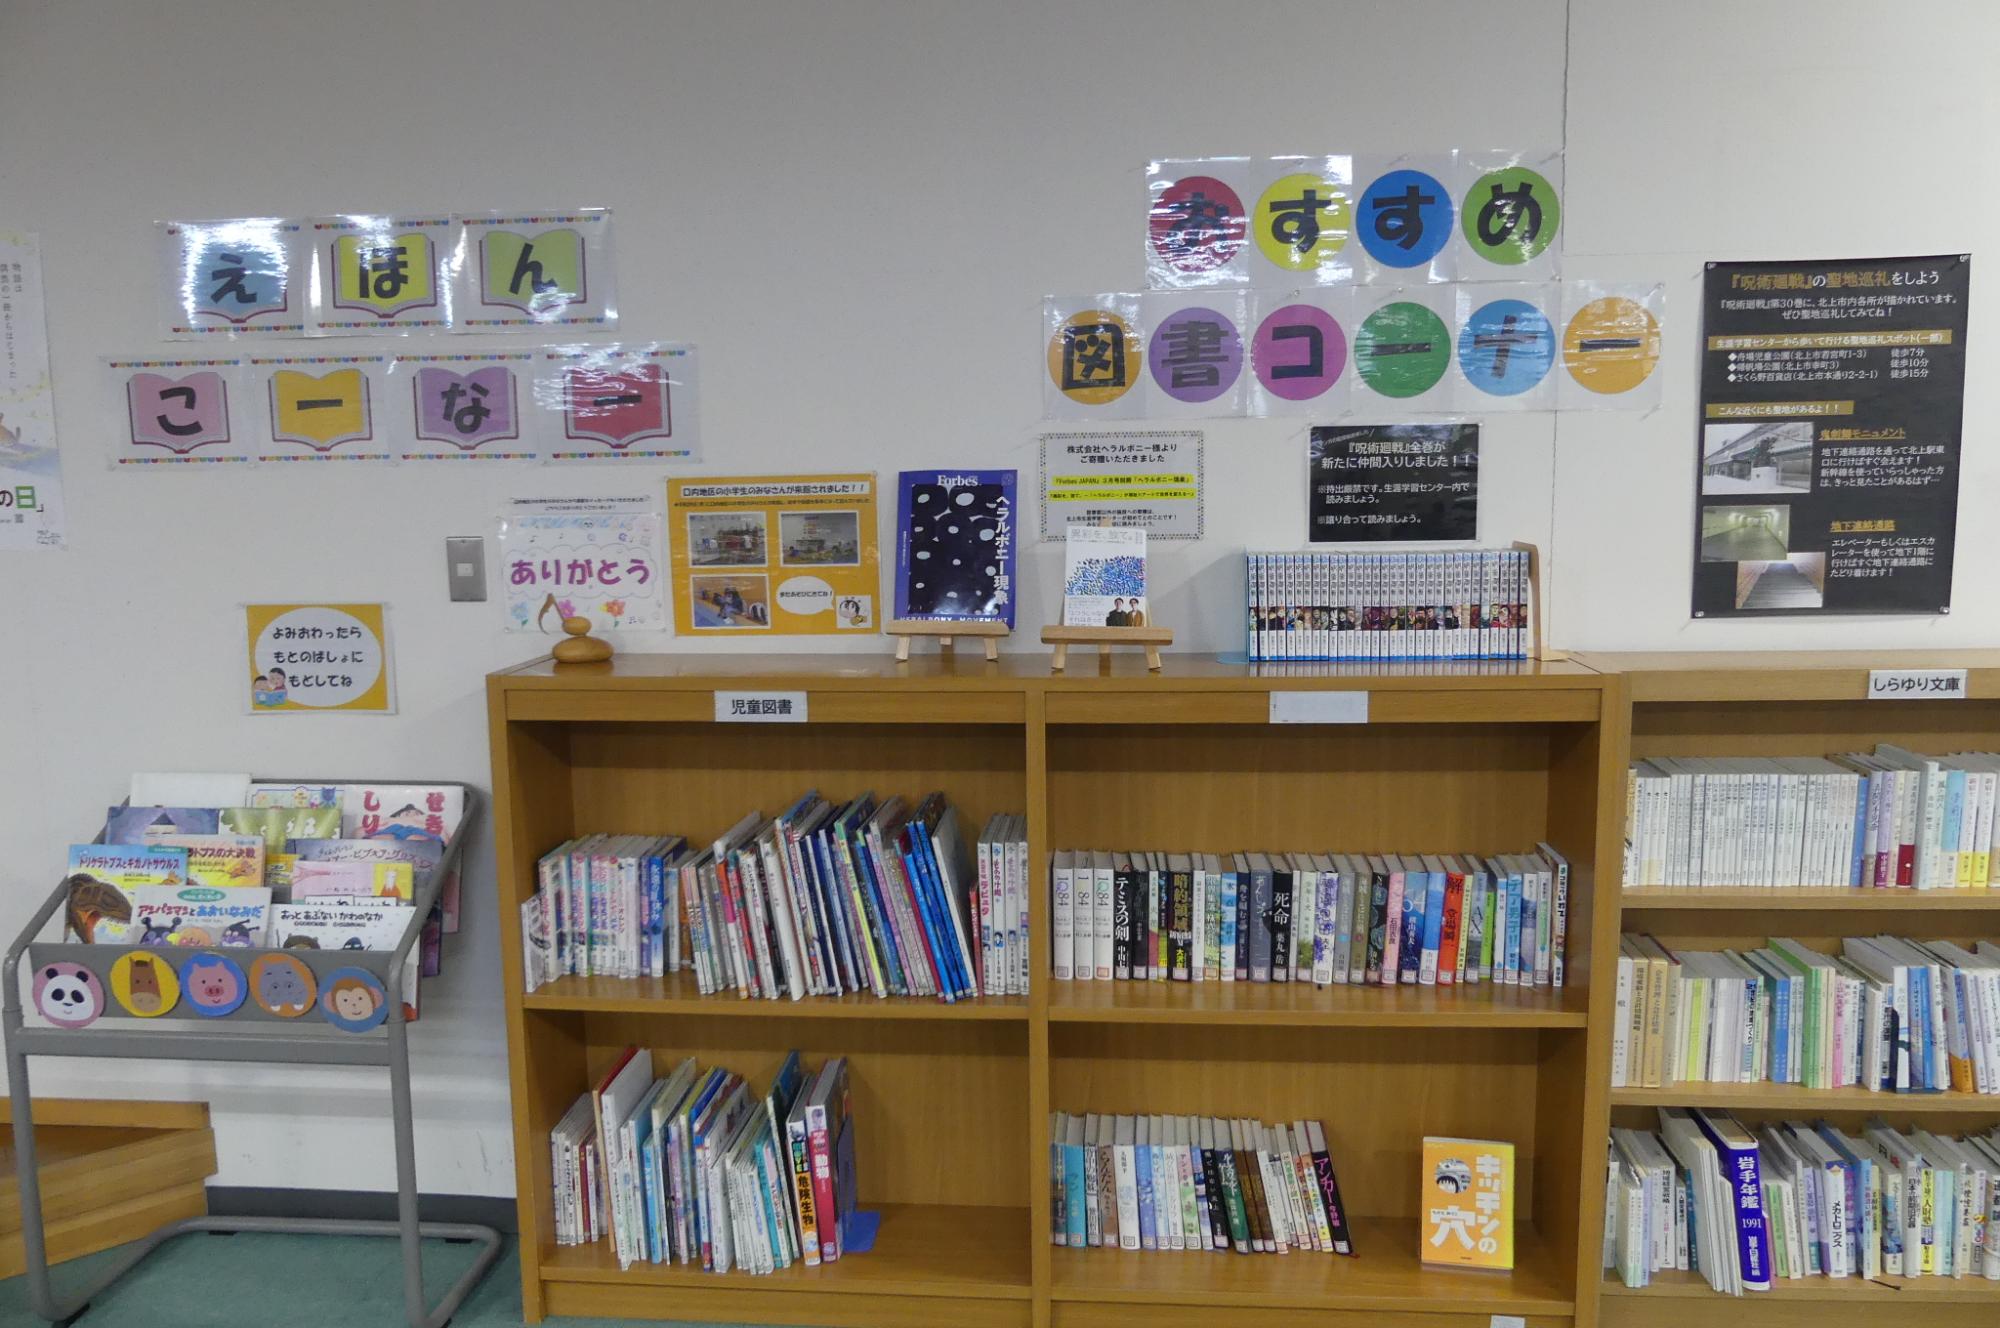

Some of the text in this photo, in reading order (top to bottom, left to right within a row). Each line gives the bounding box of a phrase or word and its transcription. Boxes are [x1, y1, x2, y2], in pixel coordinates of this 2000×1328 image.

[1168, 182, 1543, 253] おすすめ
[210, 243, 559, 304] えほん
[1061, 316, 1642, 391] 図書コーナー
[157, 382, 642, 436] こーなー
[937, 475, 978, 487] Forbes
[511, 559, 651, 586] ありがとう
[993, 496, 1011, 605] ヘラルボニー現象
[272, 626, 362, 640] よみおわったら
[288, 675, 353, 687] もどしてね
[1874, 676, 1961, 692] しらゆり文庫
[731, 698, 793, 716] 児童図書
[1115, 876, 1131, 941] テミスの剣
[1273, 892, 1291, 925] 死命
[796, 1175, 814, 1226] 危険生物
[1315, 1157, 1334, 1204] アンカー
[1476, 1153, 1501, 1255] キッチンの
[1737, 1156, 1760, 1209] 岩手年鑑
[1430, 1205, 1477, 1250] 穴
[1742, 1218, 1762, 1229] 1991
[1831, 1200, 1843, 1248] メカトロニクス
